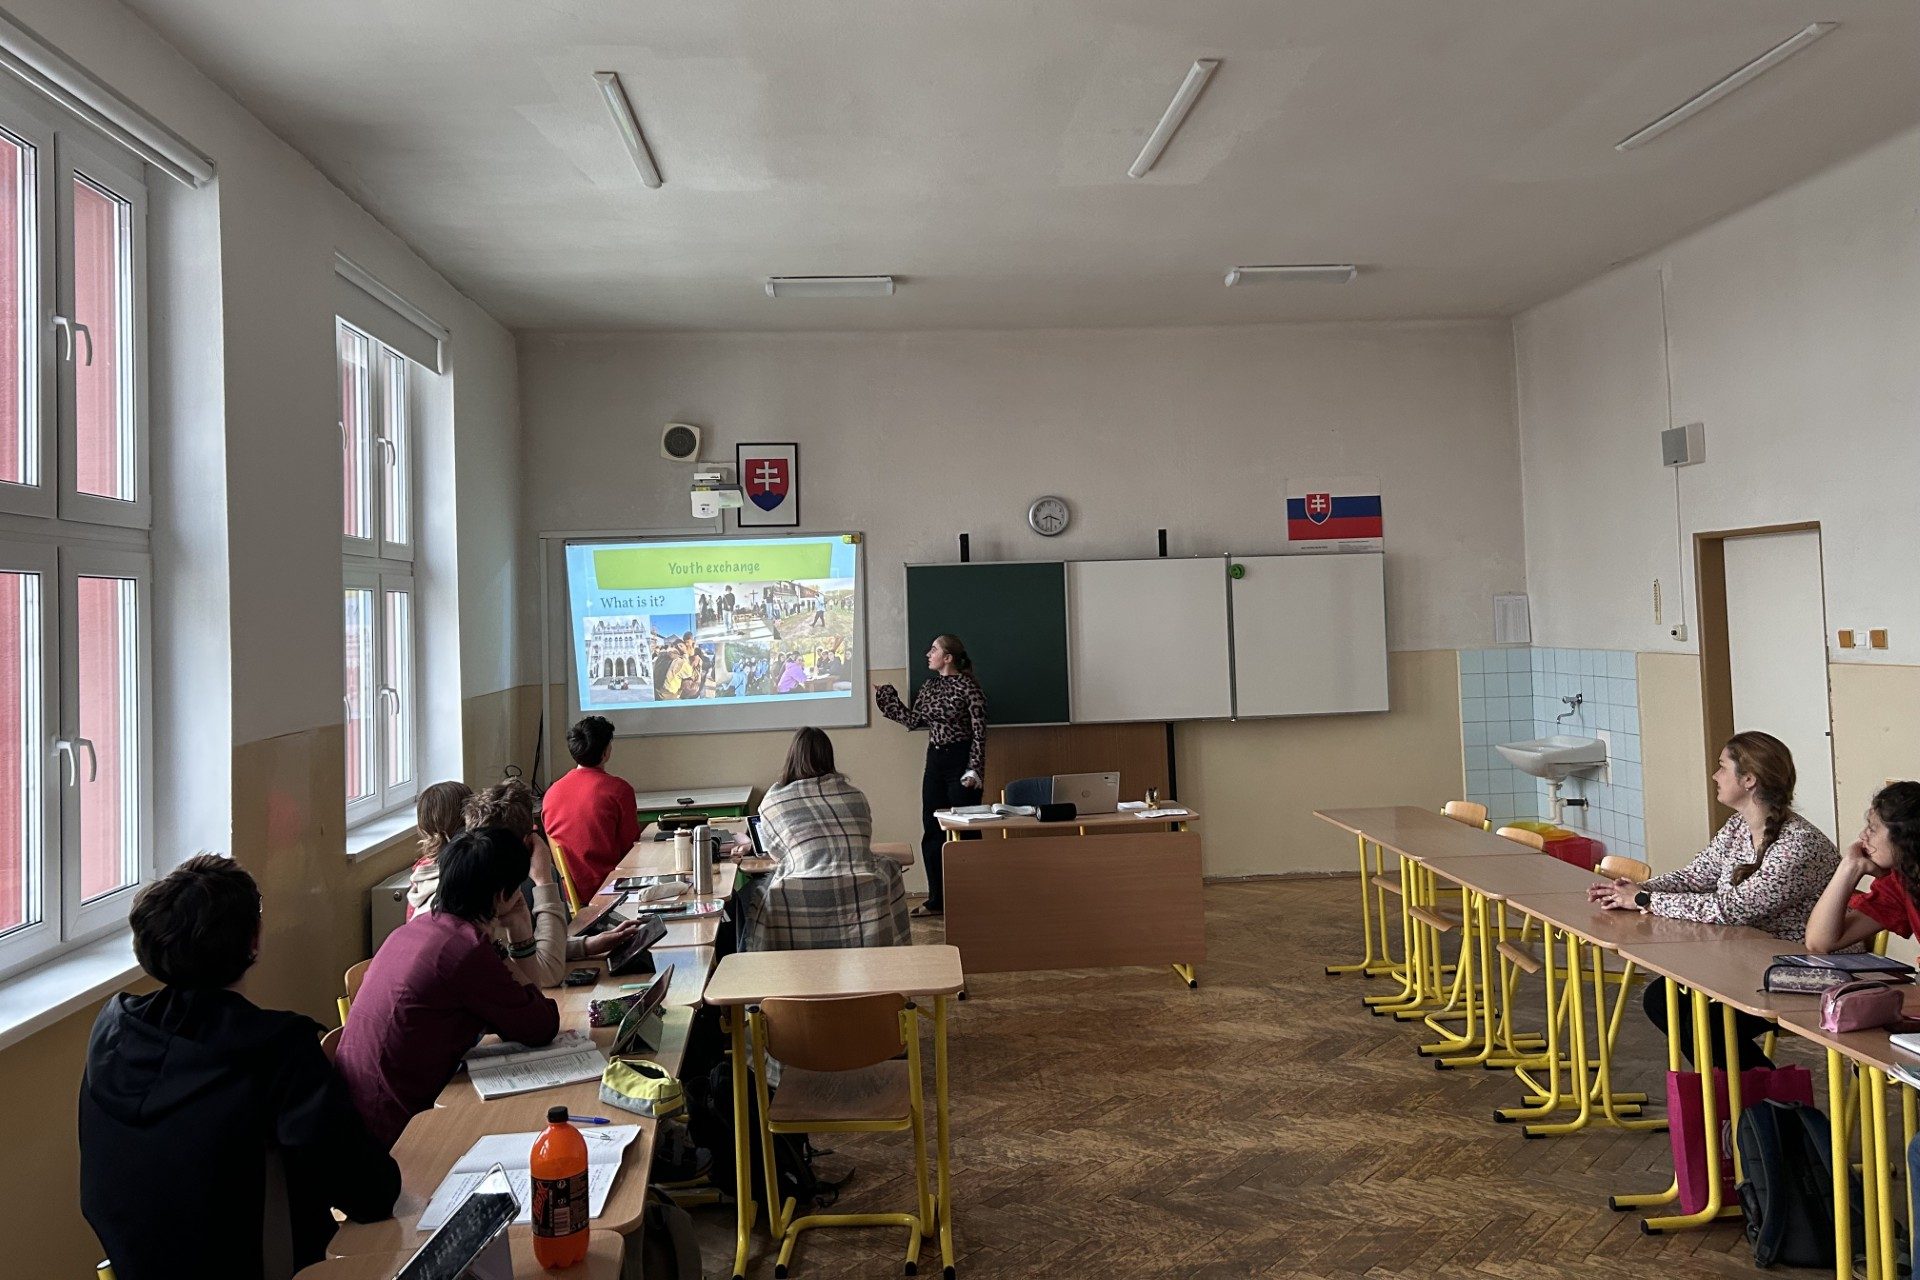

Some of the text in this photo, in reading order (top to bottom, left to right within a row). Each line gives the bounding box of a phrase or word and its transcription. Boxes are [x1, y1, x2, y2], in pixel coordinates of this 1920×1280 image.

[668, 561, 760, 575] Youth exchange
[600, 595, 665, 609] What is it?
